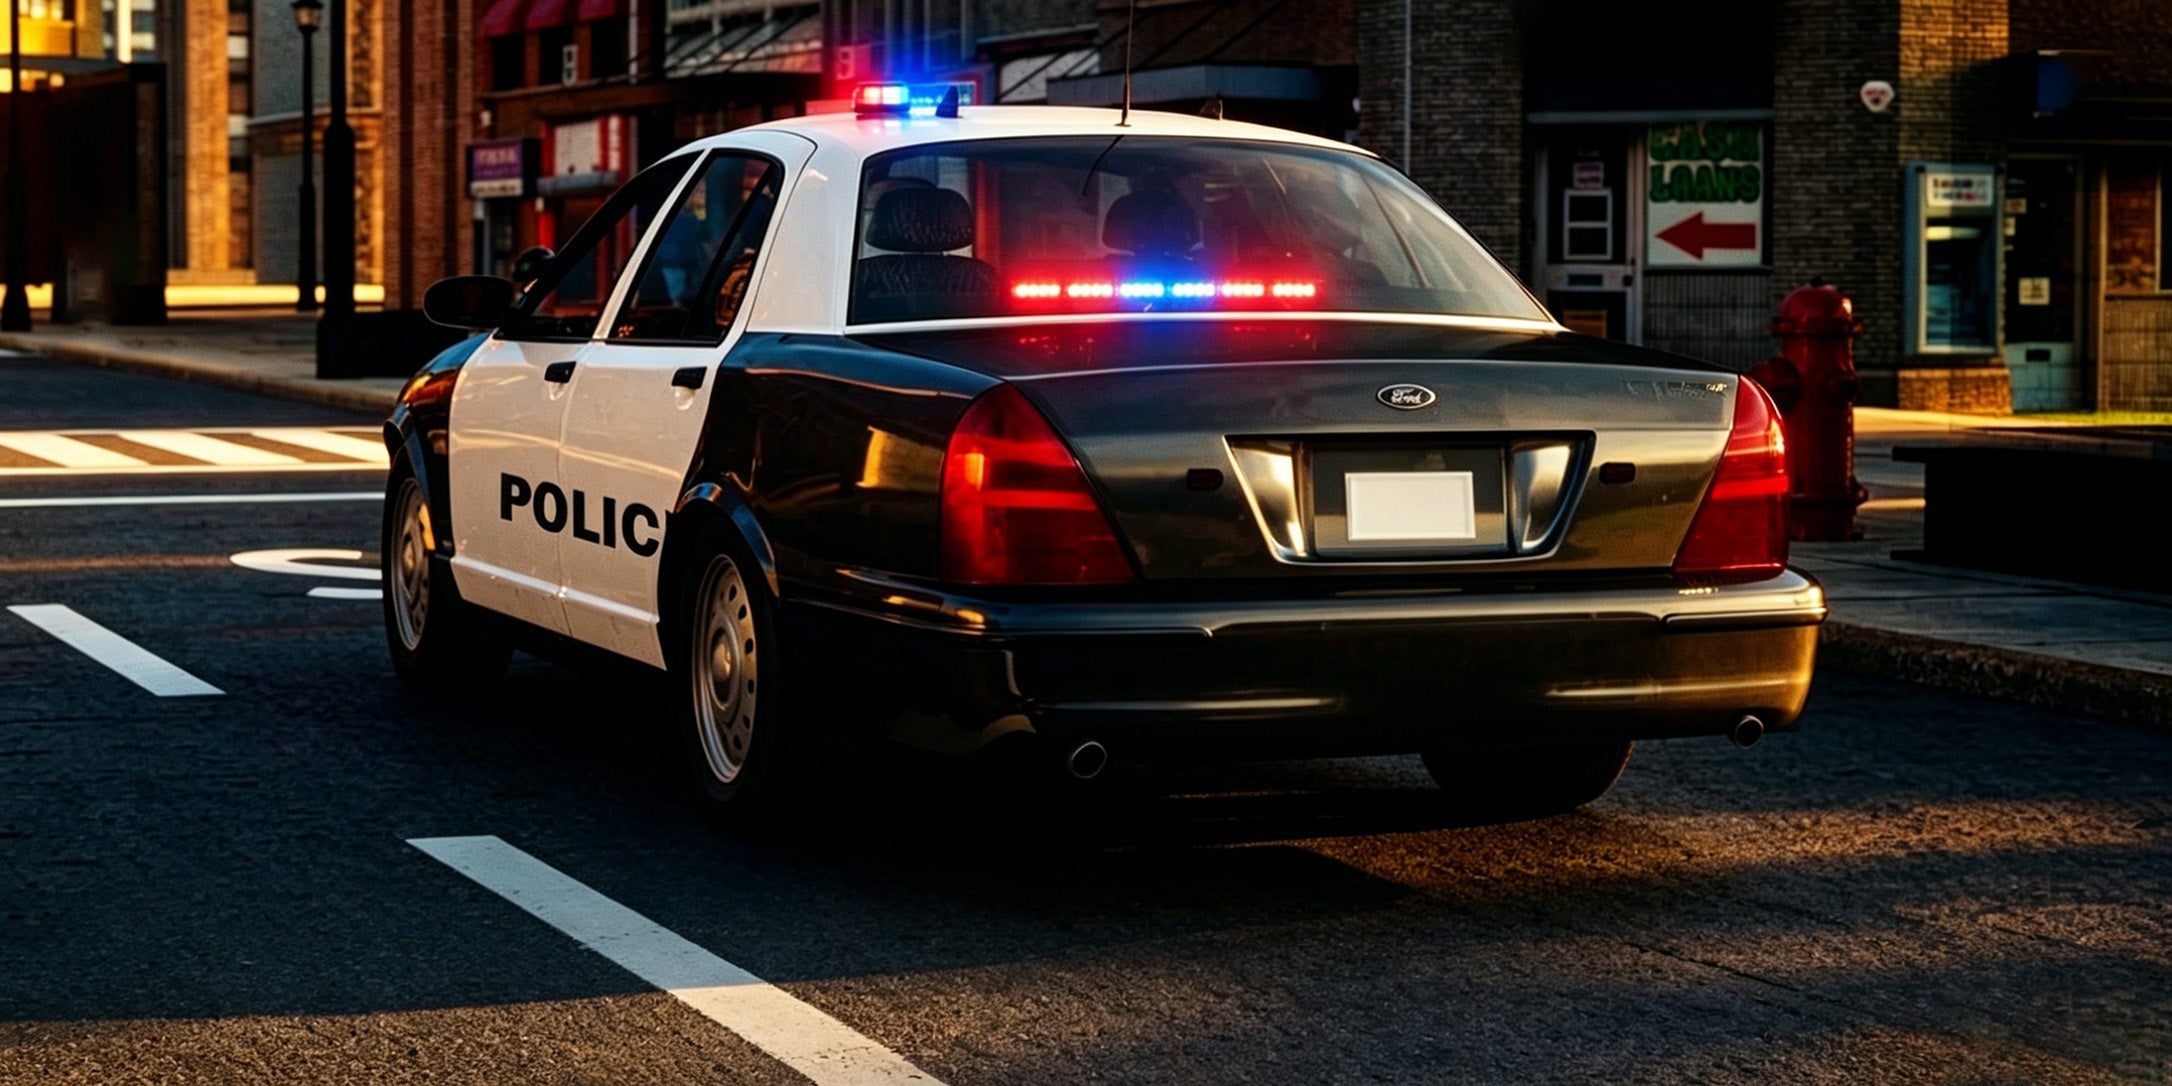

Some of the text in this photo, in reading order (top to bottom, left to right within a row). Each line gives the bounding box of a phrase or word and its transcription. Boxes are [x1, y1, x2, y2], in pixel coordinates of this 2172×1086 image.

[1650, 164, 1761, 204] LOANS
[1391, 388, 1423, 404] Ford
[500, 472, 669, 558] POLIC
